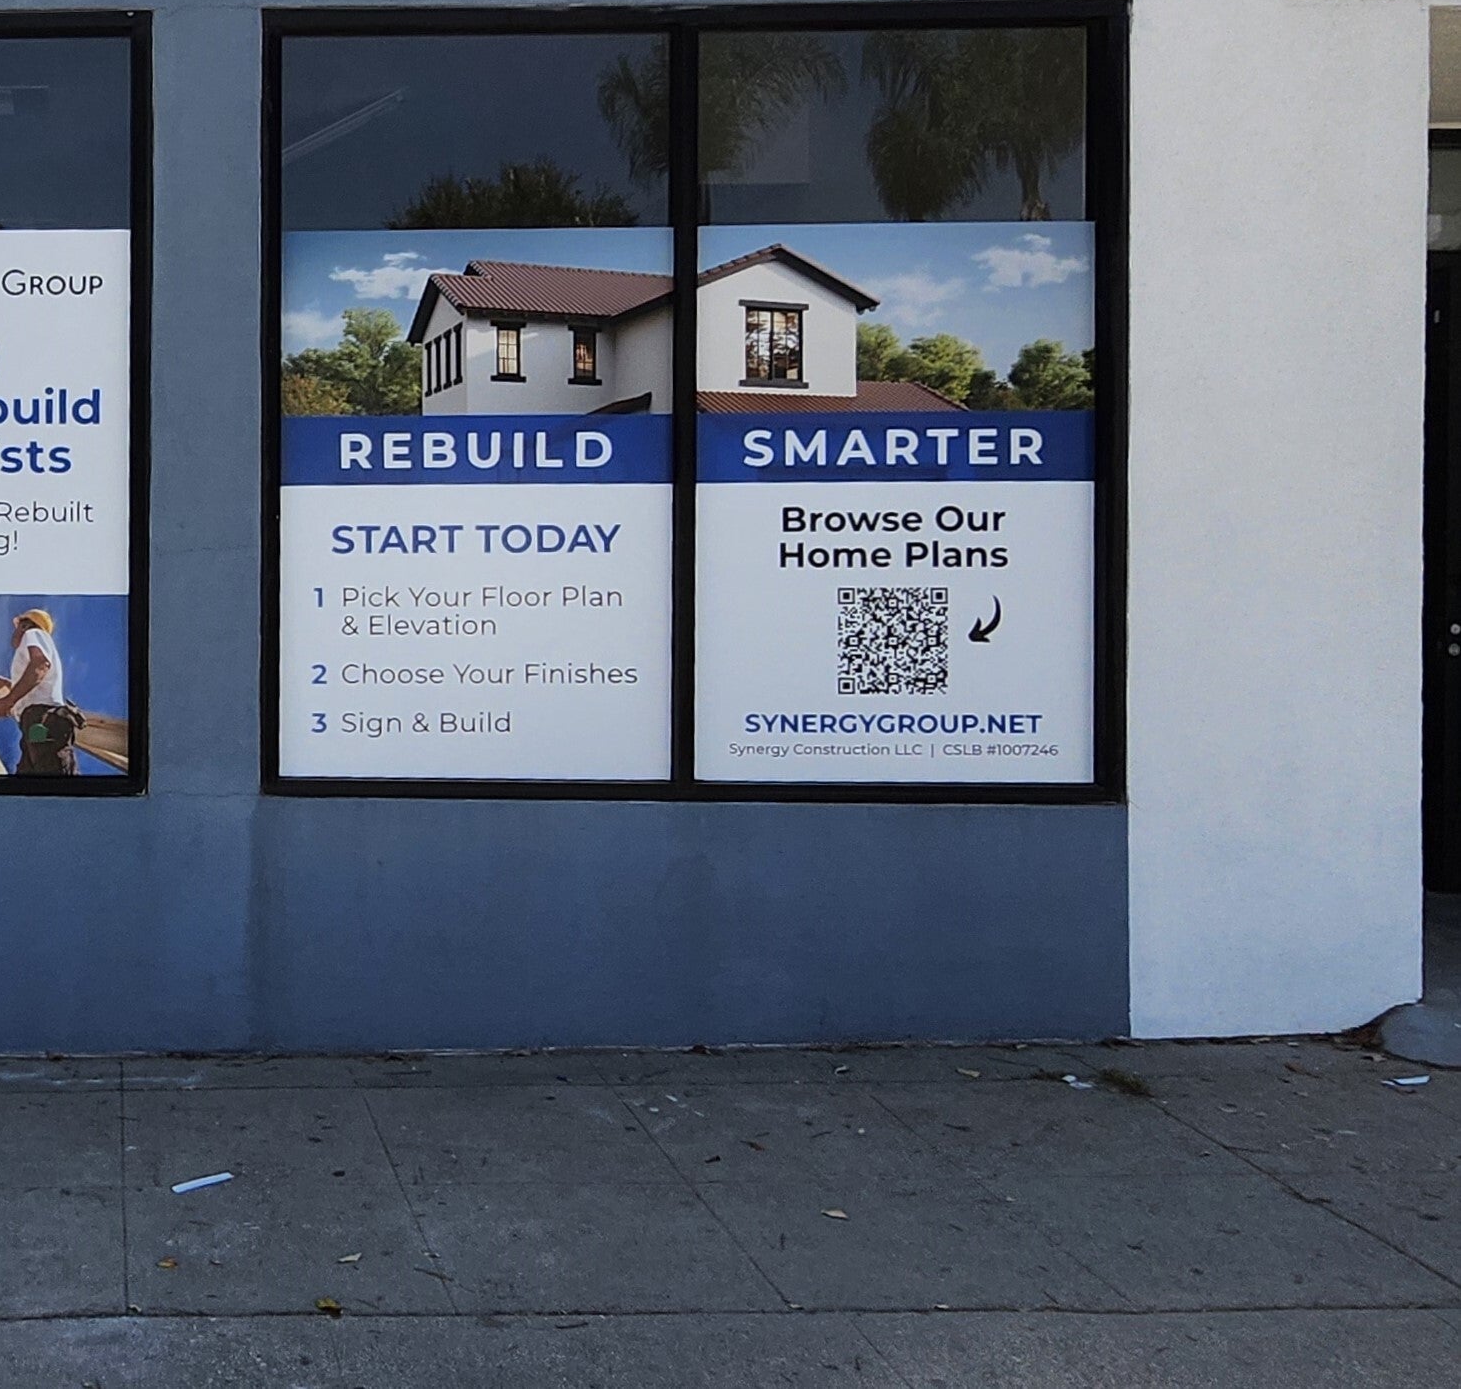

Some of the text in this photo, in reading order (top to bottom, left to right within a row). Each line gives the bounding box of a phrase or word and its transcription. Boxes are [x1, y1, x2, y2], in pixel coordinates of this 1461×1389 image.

[1, 269, 103, 296] GROUP
[340, 431, 612, 469] REBUILD
[743, 428, 1044, 466] SMARTER
[782, 506, 1006, 533] Browse Our
[332, 524, 621, 554] START TODAY
[779, 541, 1008, 568] Home Plans
[313, 586, 622, 608] 1 Pick Your Floor Plan
[341, 614, 496, 636] & Elevation
[311, 663, 638, 684] 2 Choose Your Finishes
[311, 712, 511, 738] 3 Sign & Build
[745, 714, 1042, 734] SYNERGYGROUP.NET
[729, 743, 789, 758] Synergy
[793, 743, 890, 756] Construction
[895, 744, 922, 755] LLC
[943, 744, 982, 755] CSLB
[987, 744, 1059, 756] #1007246
